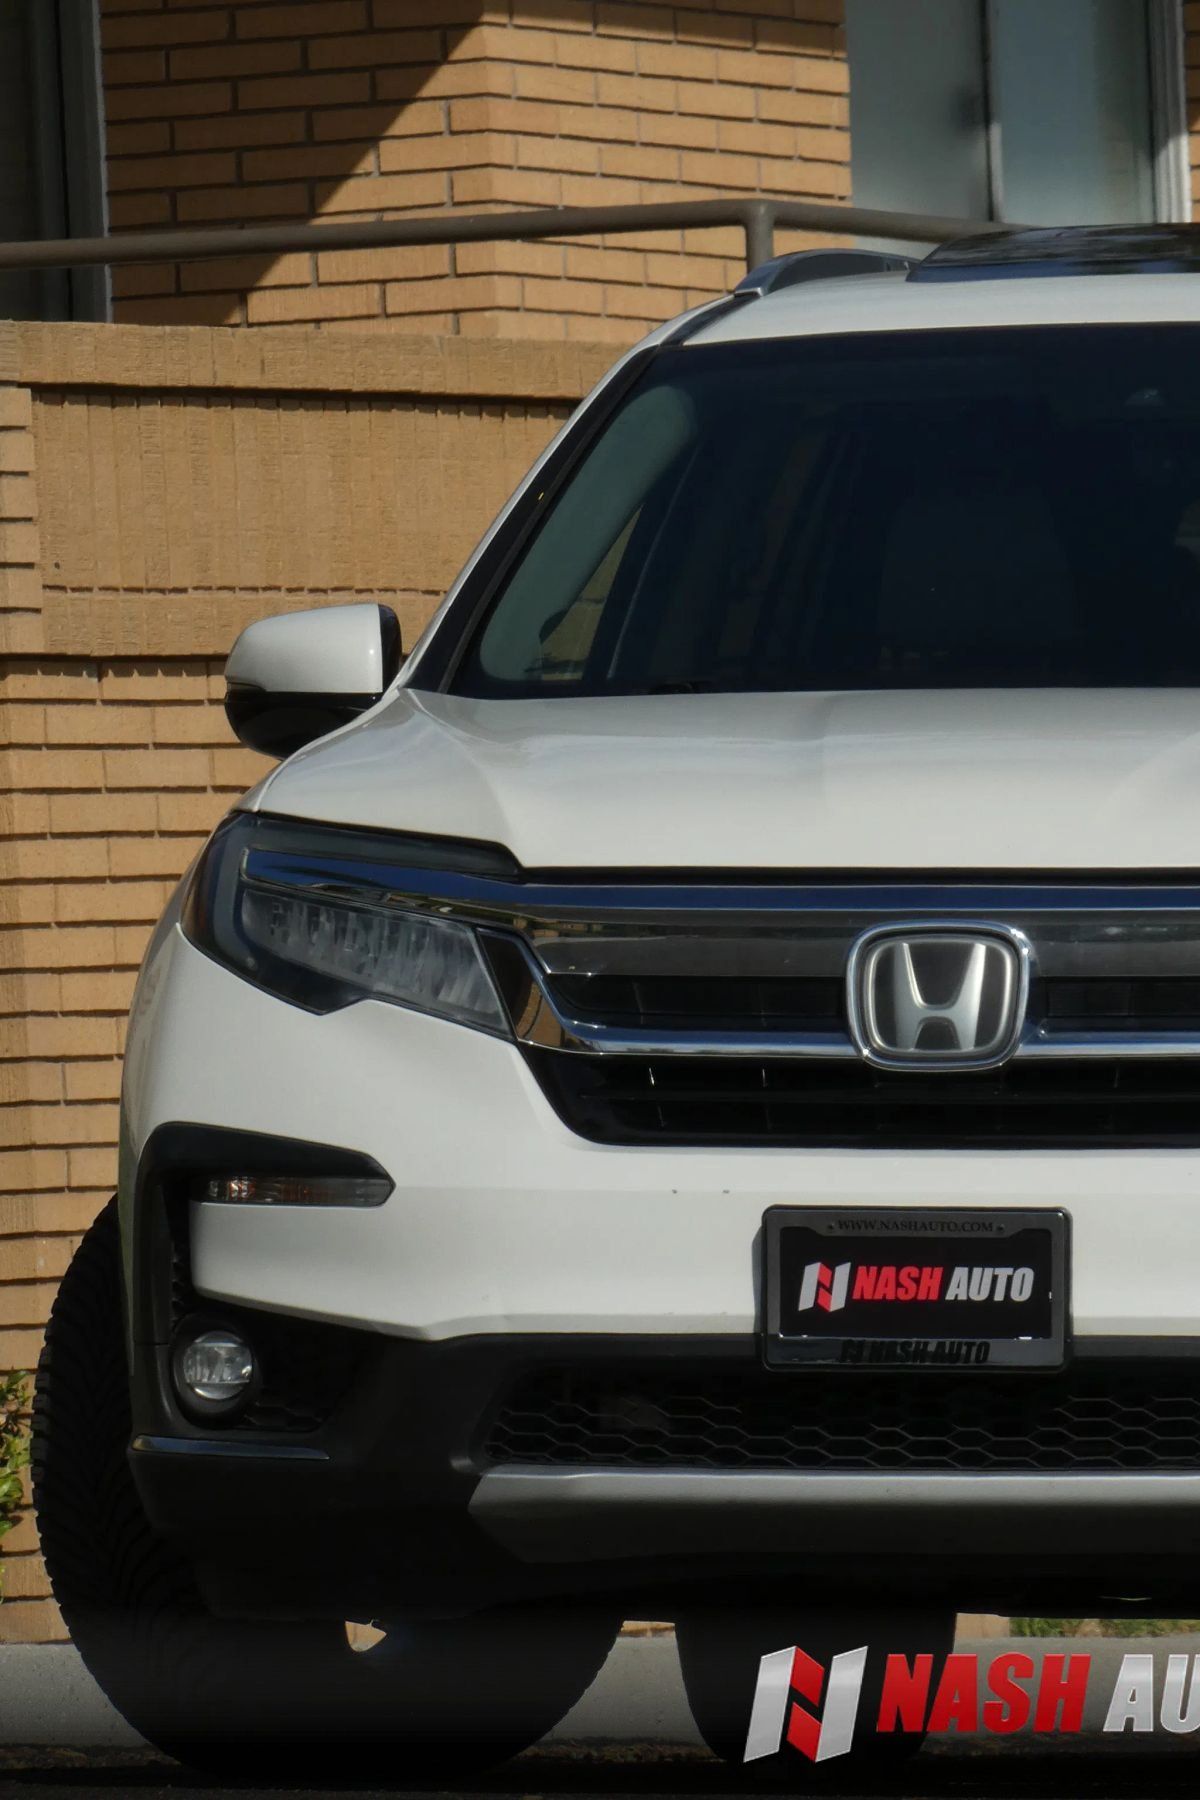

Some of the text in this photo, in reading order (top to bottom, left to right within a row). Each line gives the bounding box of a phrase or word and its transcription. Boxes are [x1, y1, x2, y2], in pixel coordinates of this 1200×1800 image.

[837, 1219, 993, 1233] WWW.NASHAUTO.COM
[852, 1266, 944, 1300] NASH
[945, 1267, 1034, 1301] AUTO
[929, 1341, 991, 1364] AUTO
